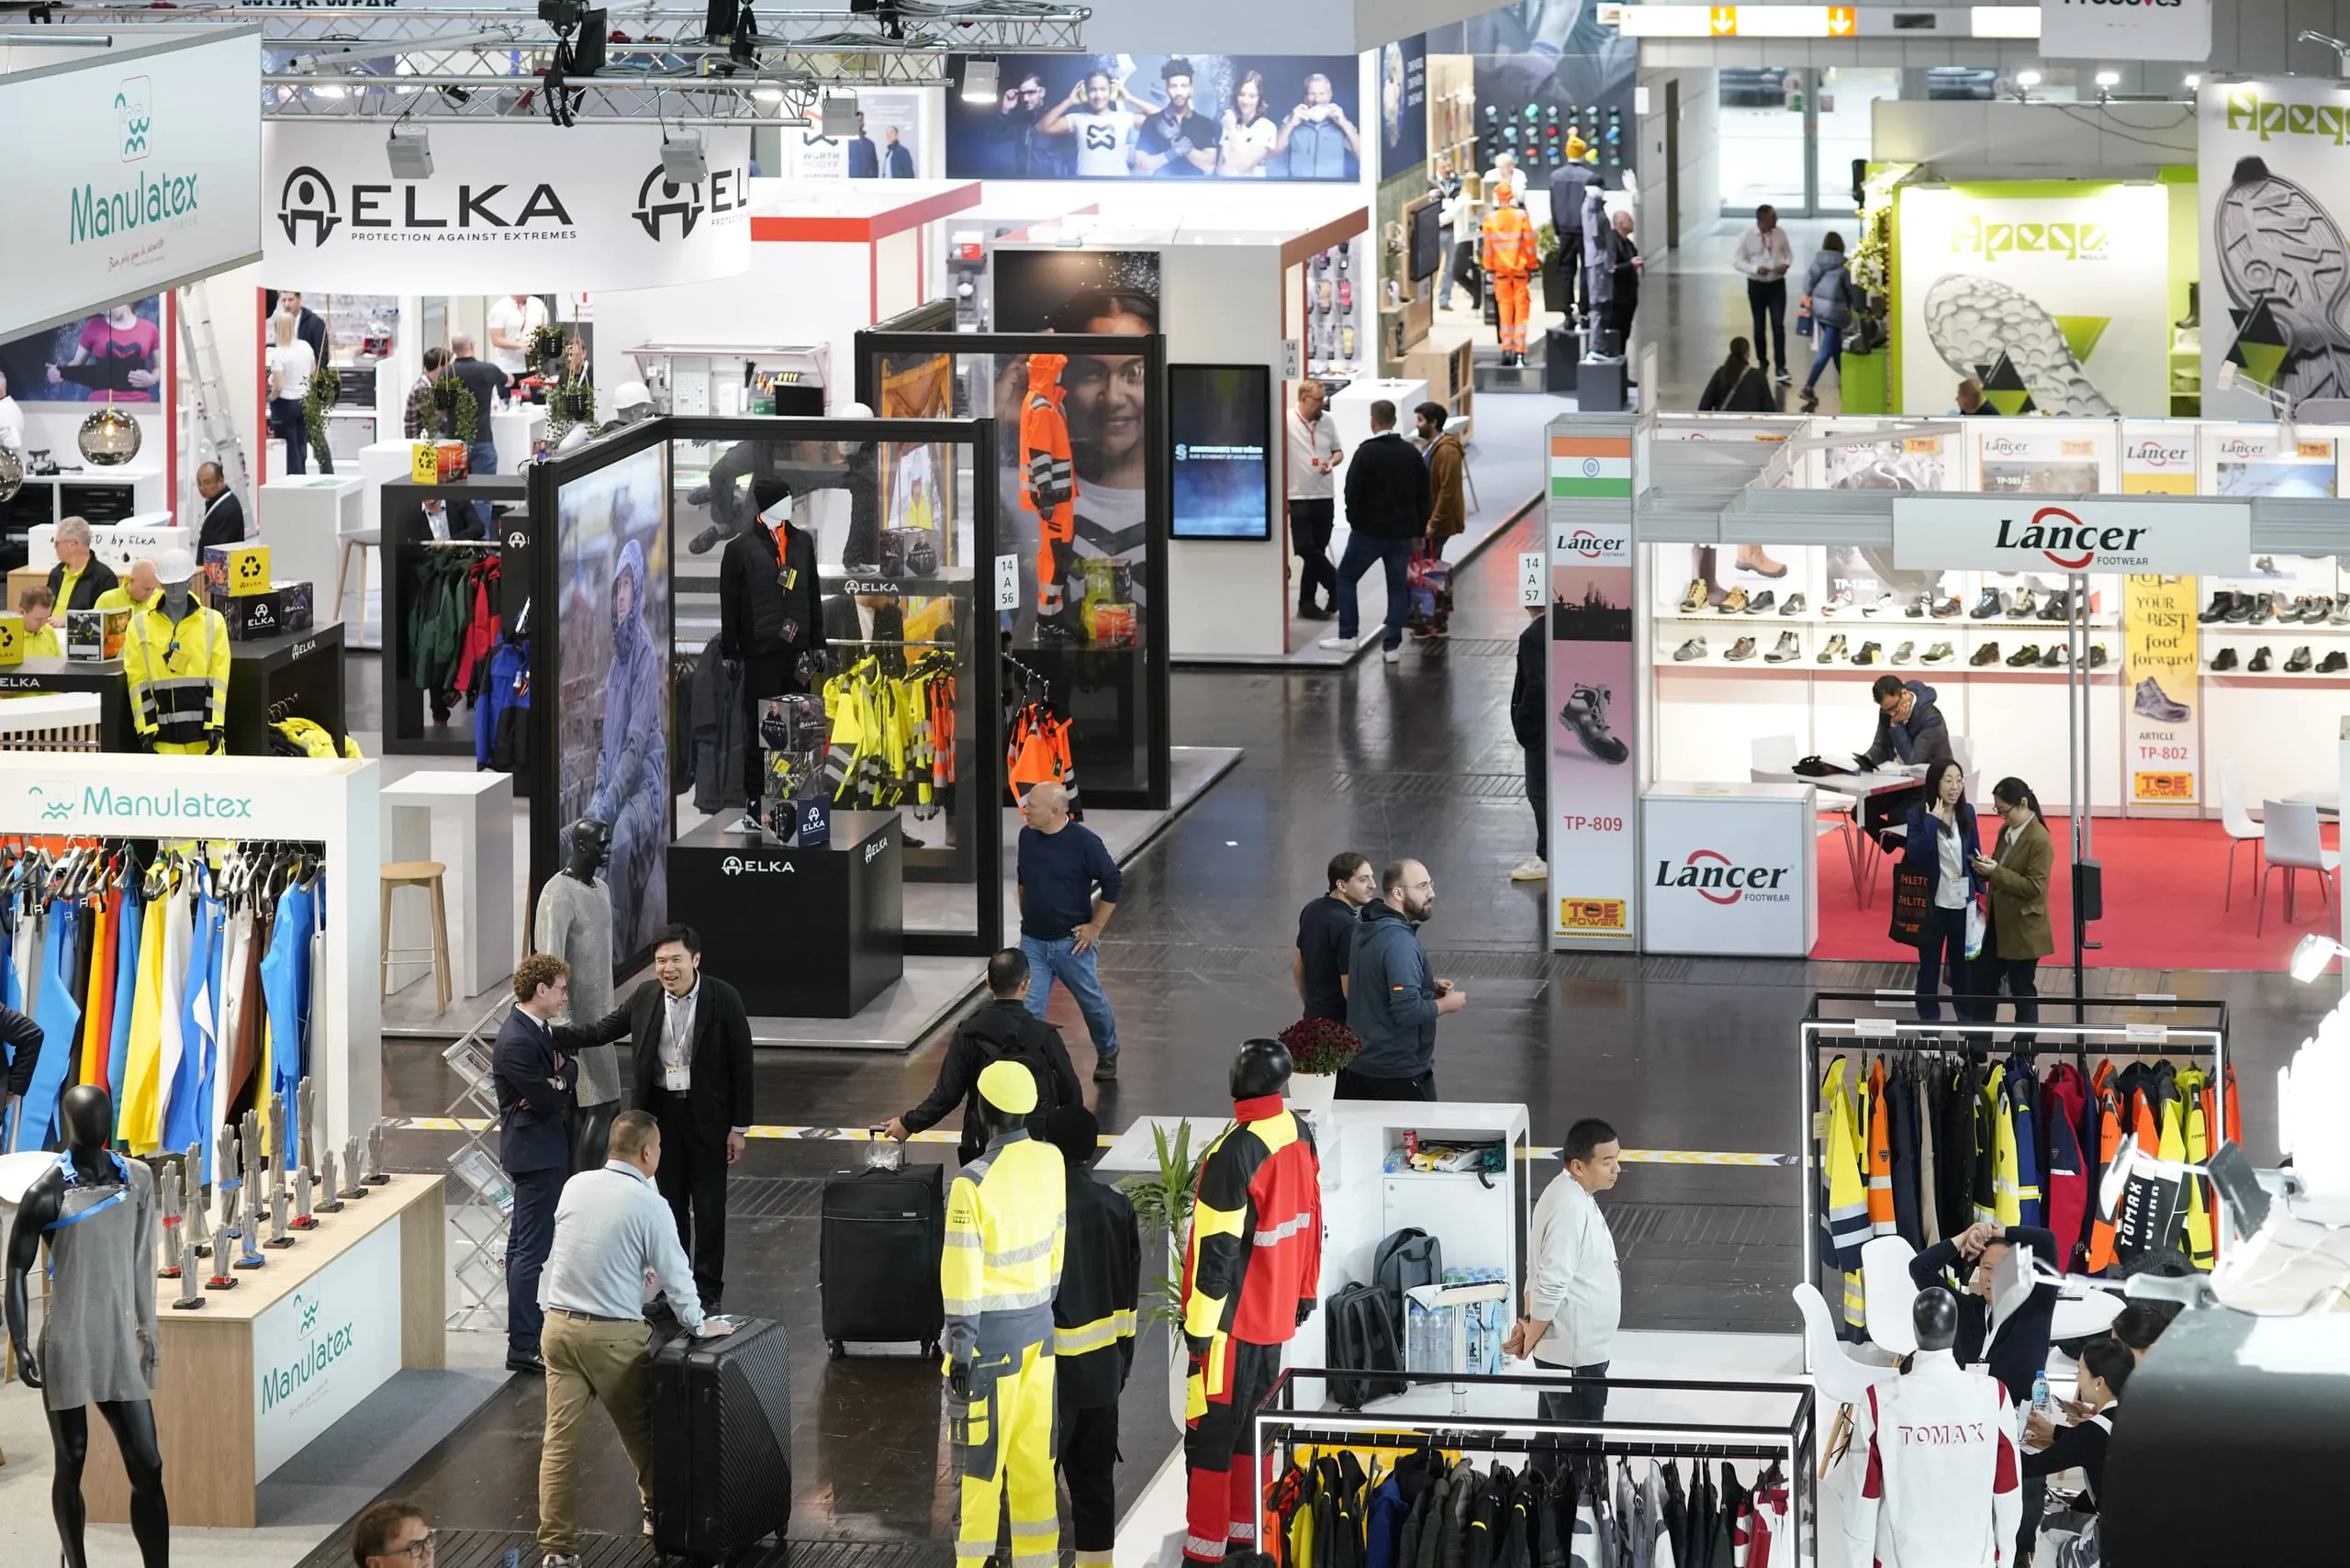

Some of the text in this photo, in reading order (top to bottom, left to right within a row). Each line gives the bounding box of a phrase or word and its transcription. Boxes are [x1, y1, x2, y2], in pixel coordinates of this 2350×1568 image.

[2228, 92, 2350, 146] Apeq
[71, 171, 197, 245] Manulatex
[352, 184, 574, 227] ELKA
[352, 231, 576, 241] PROTECTION AGAINST EXTREMES
[1286, 342, 1296, 352] 14
[1288, 355, 1294, 364] A
[1985, 441, 2029, 451] Lancer
[2127, 446, 2188, 459] Lancer
[2221, 442, 2266, 454] Lancer
[111, 533, 124, 547] by
[129, 535, 157, 545] ELKA
[1995, 520, 2147, 551] Lancer
[1556, 535, 1625, 551] Lancer
[1002, 560, 1013, 572] 14
[1526, 557, 1539, 569] 14
[2097, 556, 2149, 566] FOOTWEAR
[1003, 577, 1012, 588] A
[1528, 574, 1537, 585] A
[861, 583, 900, 592] ELKA
[1002, 592, 1013, 604] 56
[1525, 589, 1539, 601] 57
[2136, 596, 2175, 609] YOUR
[248, 616, 274, 627] ELKA
[2147, 612, 2188, 633] BEST
[299, 639, 317, 655] ELKA
[2146, 634, 2178, 653] foot
[2132, 653, 2193, 671] forward
[0, 678, 40, 688] ELKA
[2139, 732, 2175, 741] ARTICLE
[2139, 746, 2188, 760] TP-802
[2141, 776, 2188, 790] TOE
[83, 786, 252, 819] Manulatex
[802, 820, 825, 832] ELKA
[1563, 815, 1624, 832] TP-809
[871, 836, 889, 857] ELKA
[744, 860, 795, 873] ELKA
[1655, 861, 1789, 890] Lancer
[1744, 893, 1790, 902] FOOTWEAR
[1568, 902, 1619, 919] TOE
[1568, 918, 1619, 927] POWER
[2121, 1181, 2143, 1247] TOMAX
[263, 1322, 352, 1415] Manulatex
[1898, 1422, 1985, 1445] TOMAX
